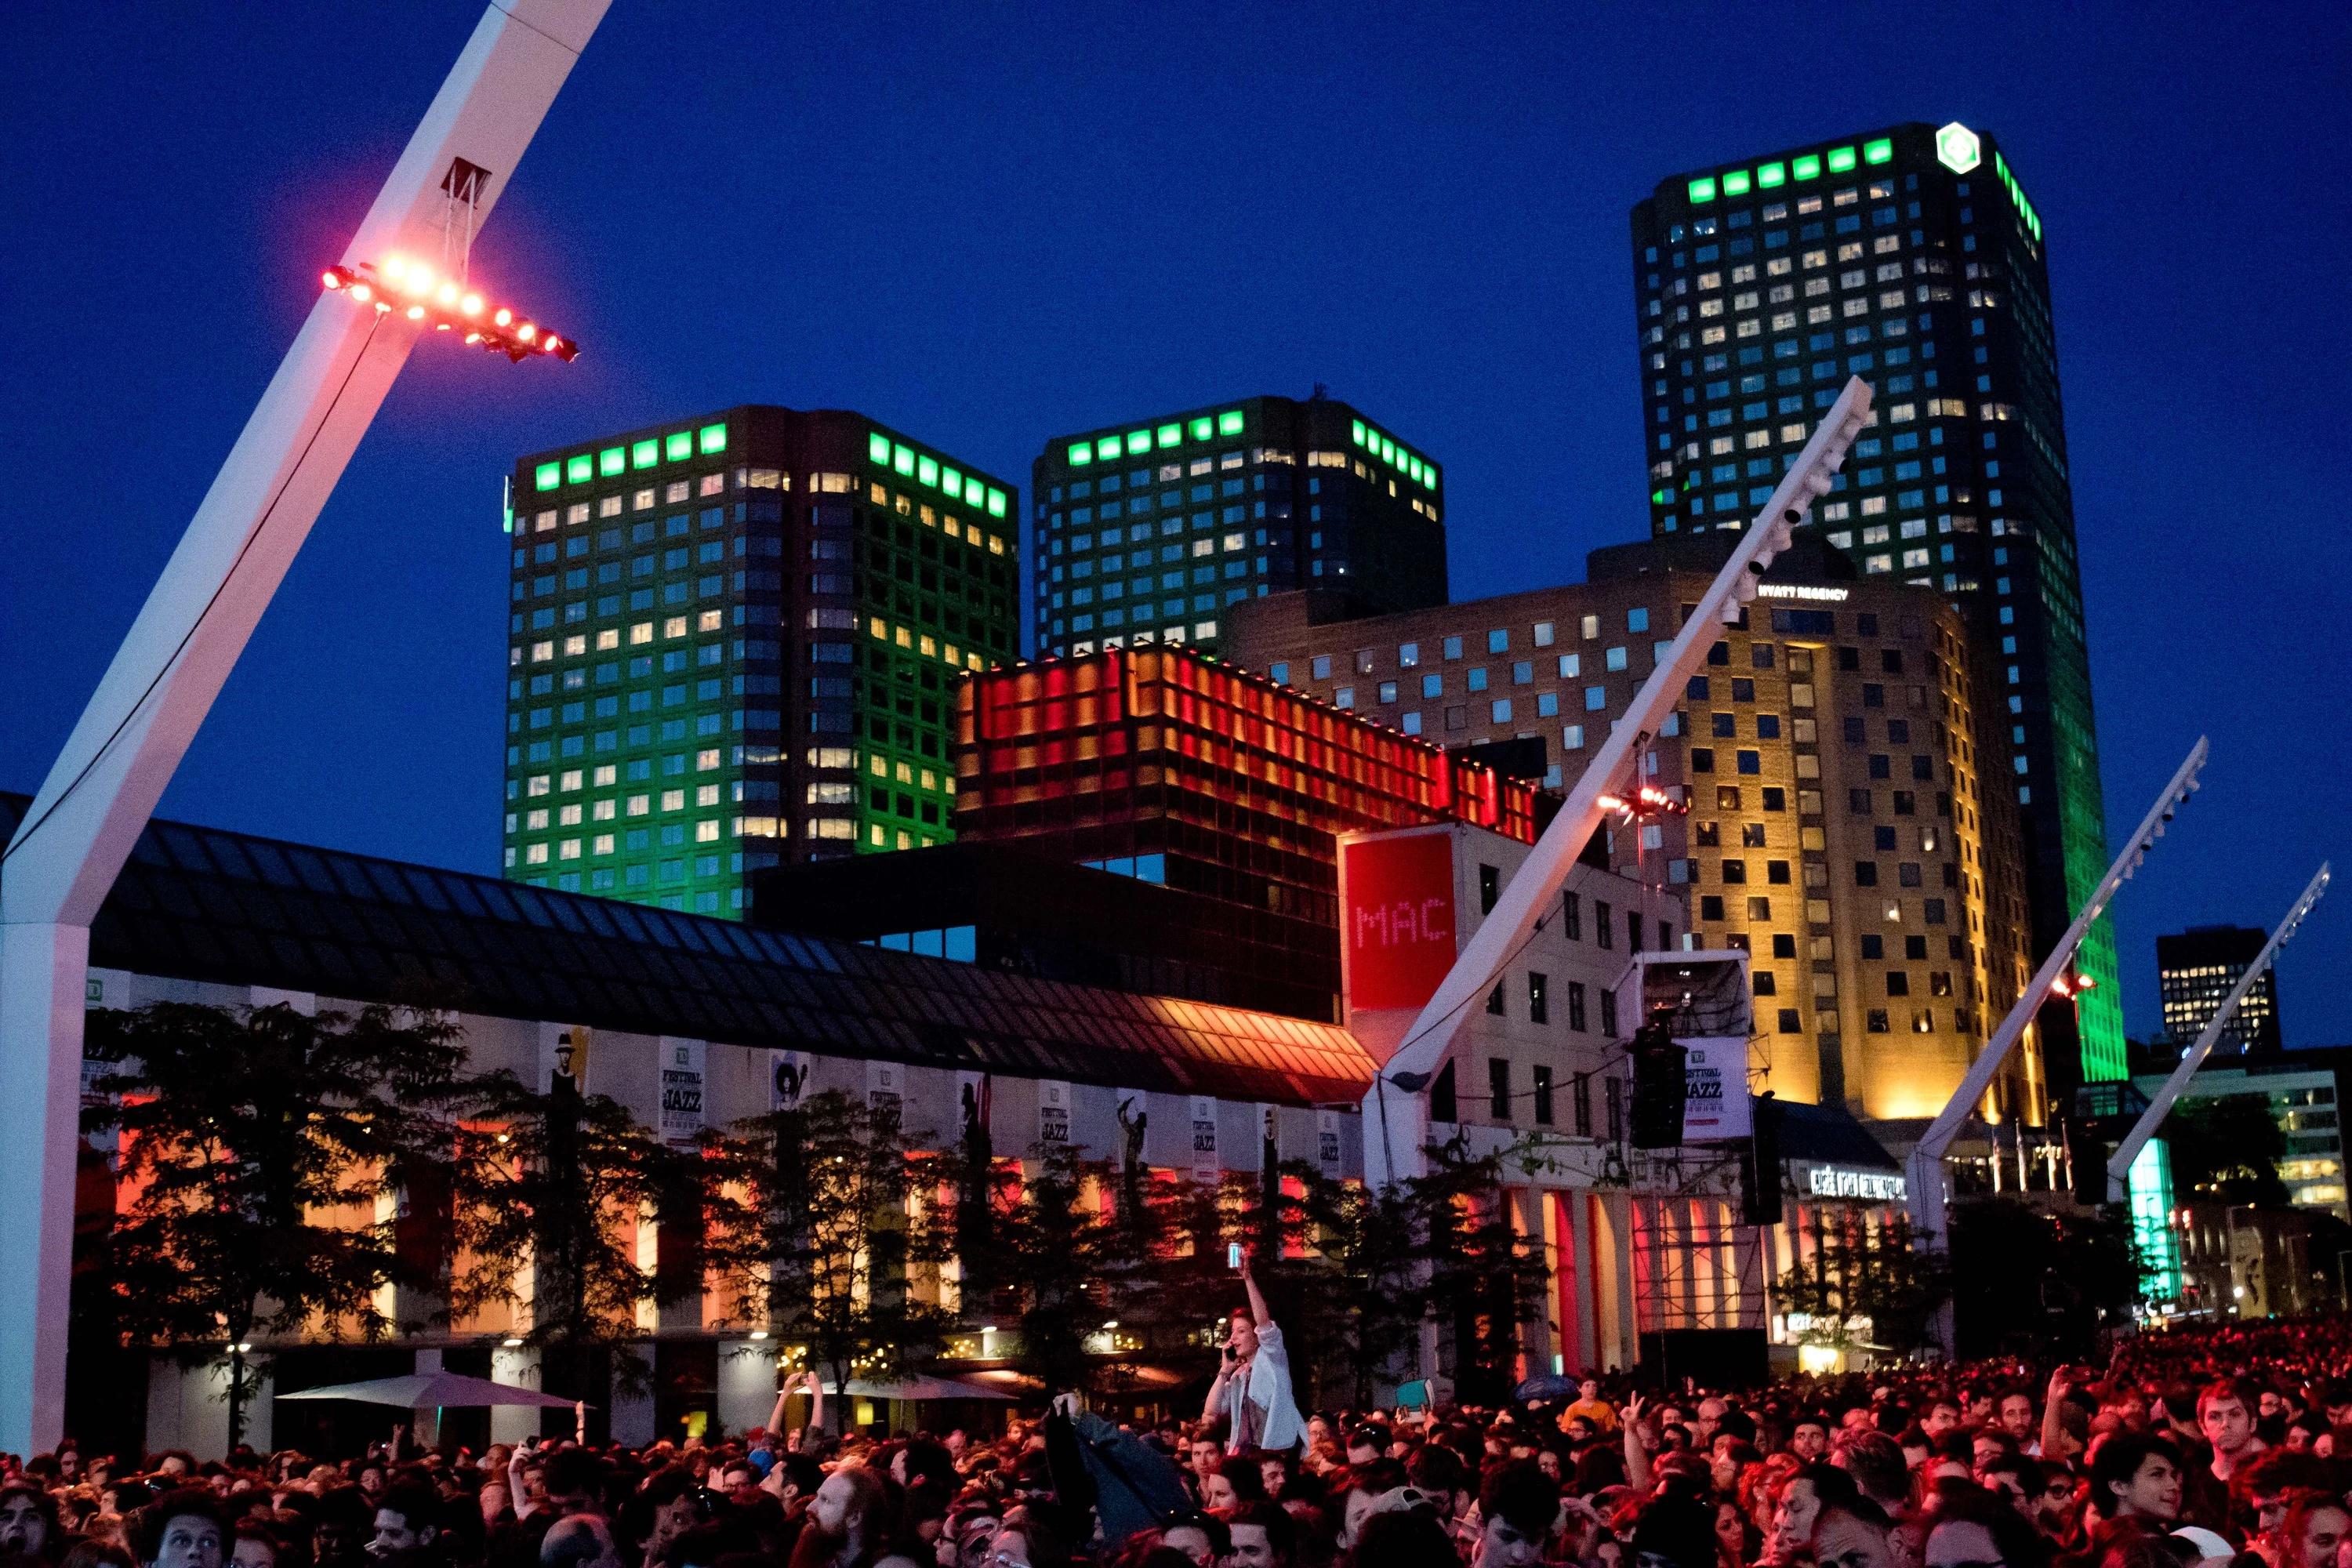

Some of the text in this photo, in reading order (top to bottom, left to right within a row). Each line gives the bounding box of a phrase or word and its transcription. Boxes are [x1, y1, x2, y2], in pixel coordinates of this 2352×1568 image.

[1759, 585, 1848, 601] HYATT REGENCY
[1356, 897, 1447, 949] MAC
[662, 1069, 702, 1084] FESTIVAL
[1684, 1068, 1721, 1079] ESTIVAL
[662, 1089, 702, 1112] JAZZ
[1042, 1123, 1068, 1142] JAZZ
[1193, 1135, 1215, 1152] JAZZ
[1319, 1146, 1338, 1162] JAZZ
